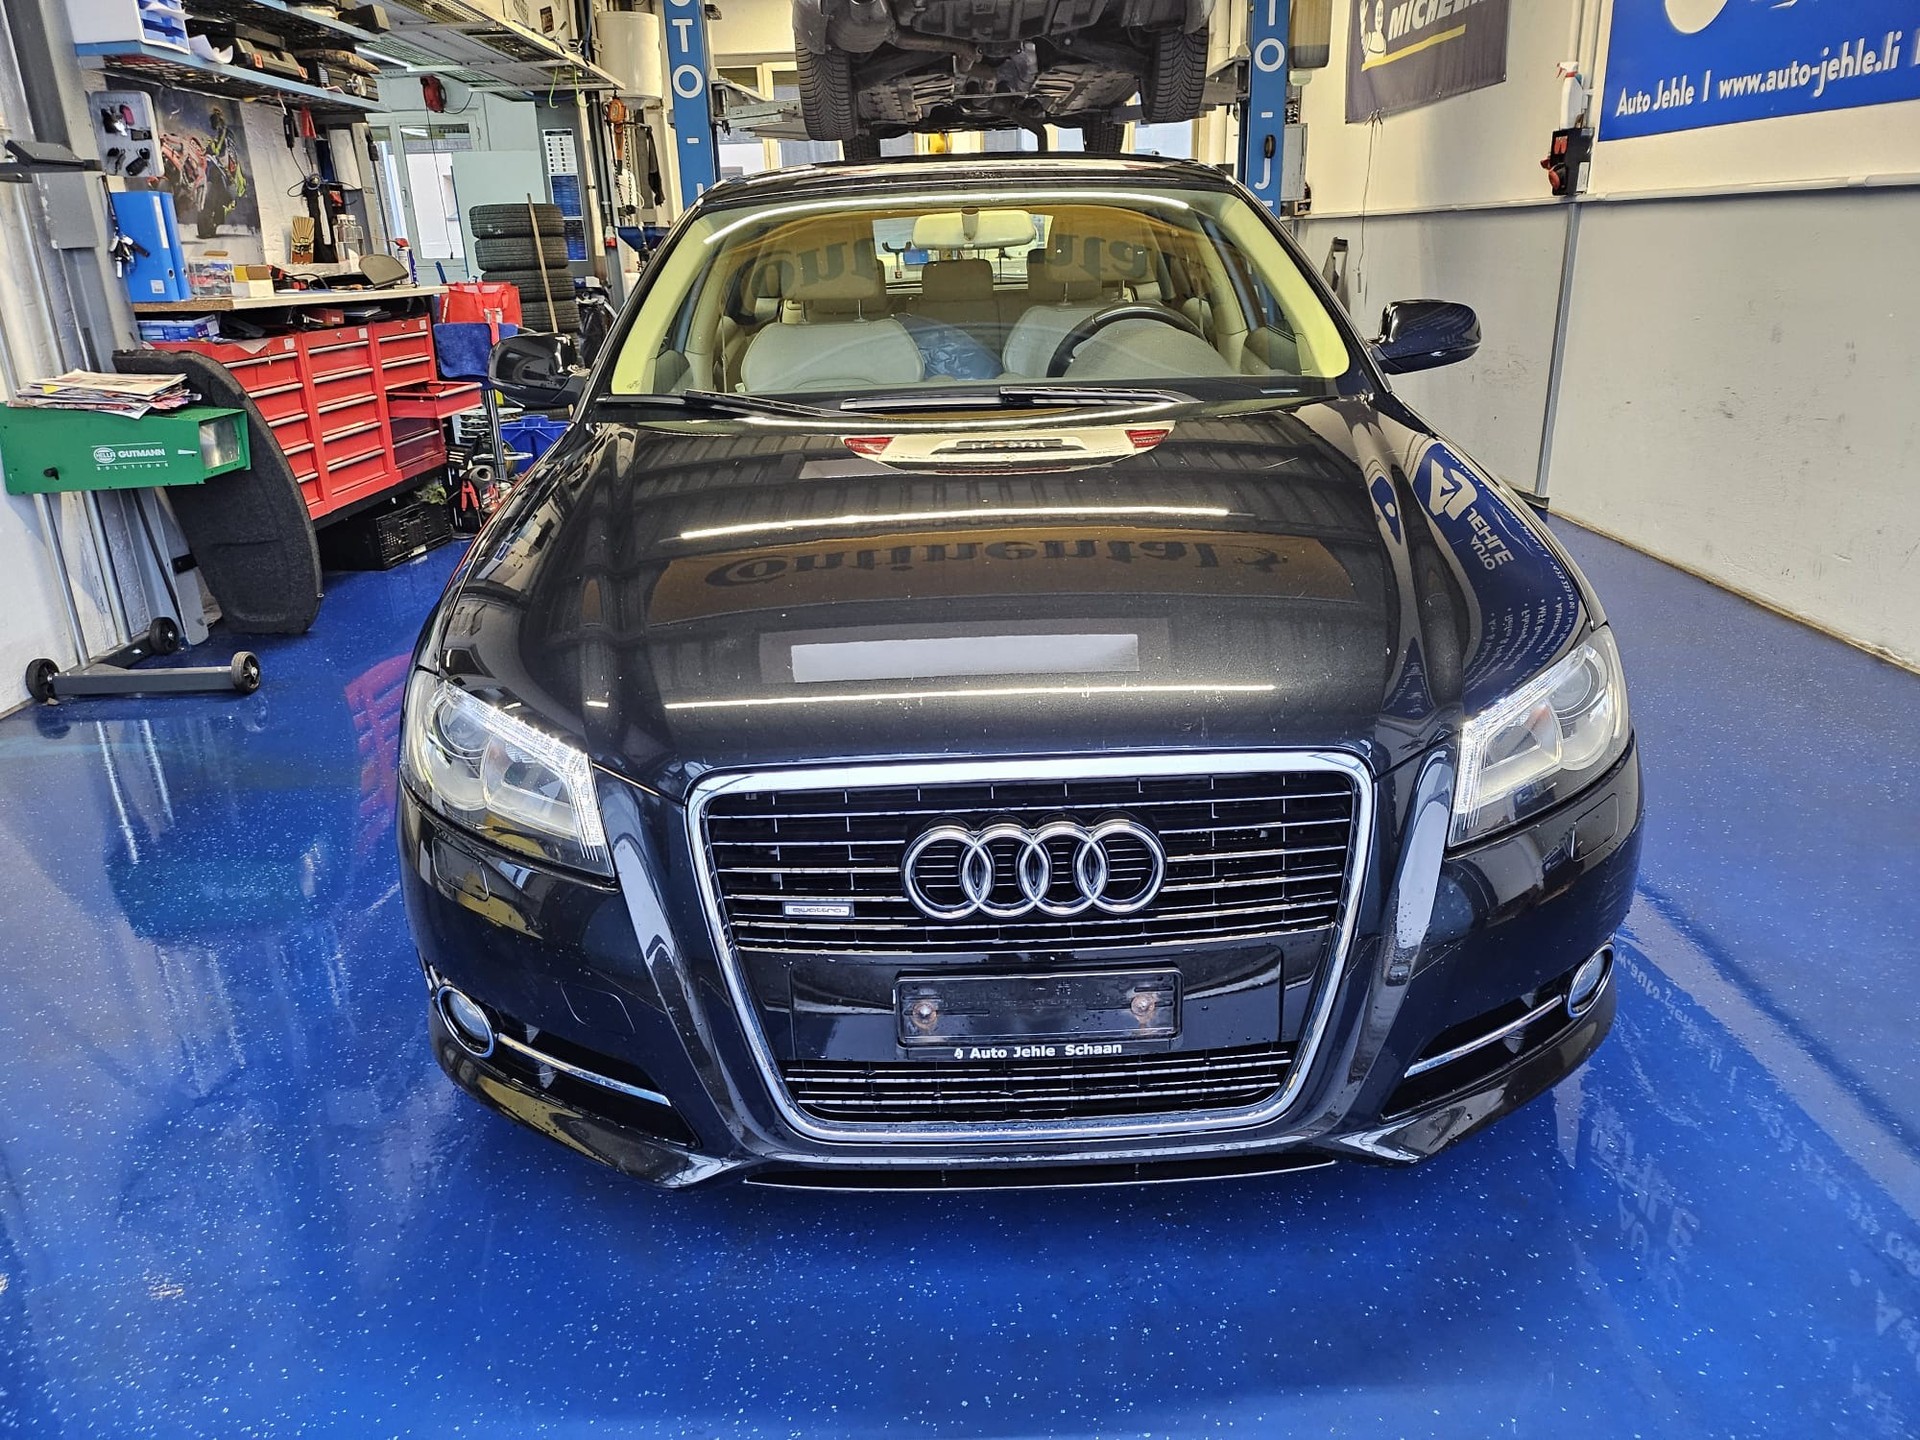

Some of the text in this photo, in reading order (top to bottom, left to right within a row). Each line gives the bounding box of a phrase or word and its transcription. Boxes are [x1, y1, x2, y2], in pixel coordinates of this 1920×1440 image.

[1387, 0, 1482, 42] MICHE
[1615, 86, 1651, 117] Auto
[1652, 74, 1695, 111] Jehle
[1719, 30, 1903, 100] www.auto-jehle.li
[118, 448, 166, 459] GUTMANN
[969, 1042, 1122, 1060] Auto Jehle Schaan
